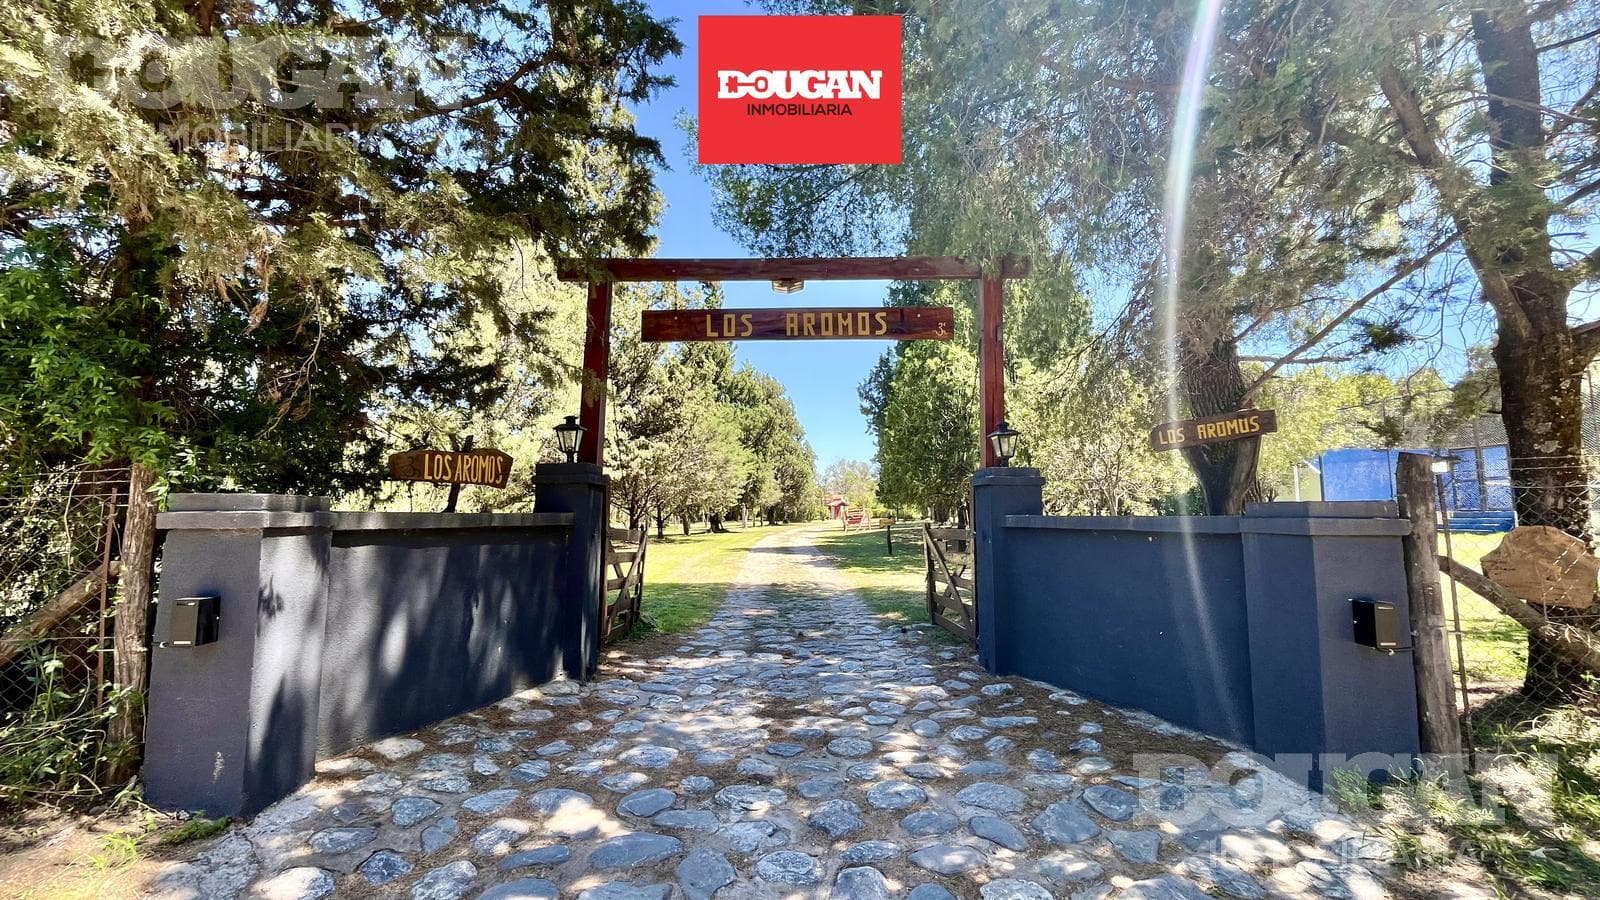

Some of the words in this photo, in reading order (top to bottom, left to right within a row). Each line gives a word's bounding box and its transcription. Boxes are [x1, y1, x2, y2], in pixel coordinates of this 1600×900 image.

[706, 314, 753, 337] LOS
[786, 312, 888, 336] AROMOS
[1158, 427, 1185, 445] LOS
[1197, 415, 1260, 439] AROMOS
[424, 453, 453, 480] LOS
[454, 455, 503, 484] AROMOS
